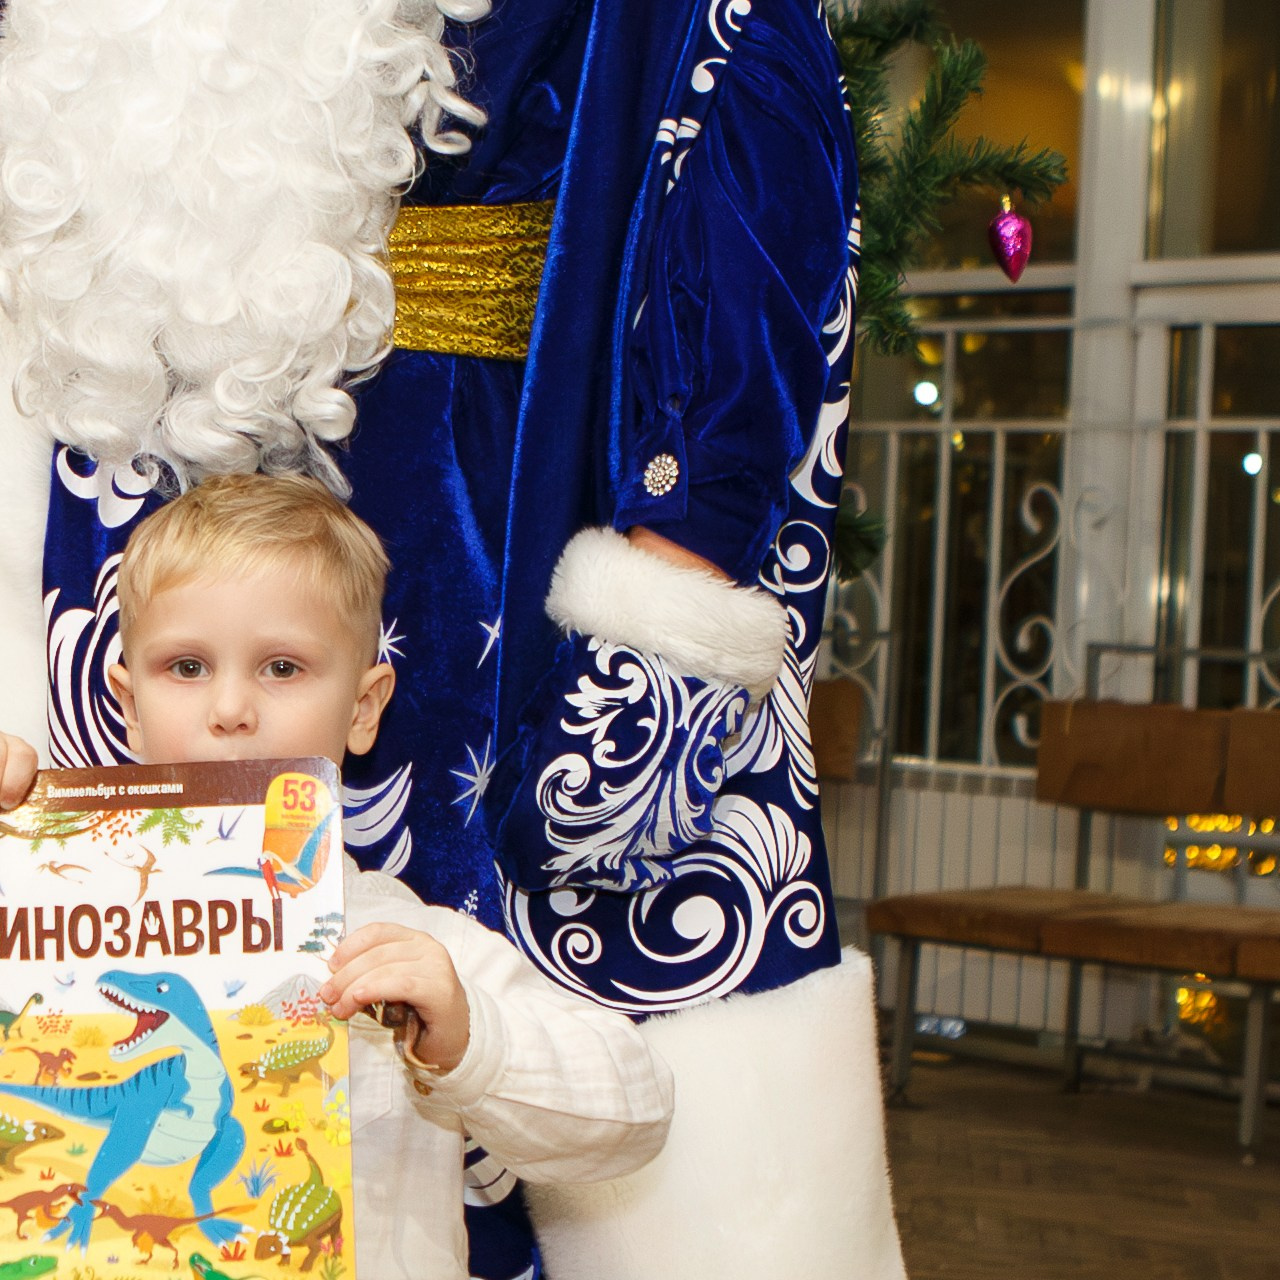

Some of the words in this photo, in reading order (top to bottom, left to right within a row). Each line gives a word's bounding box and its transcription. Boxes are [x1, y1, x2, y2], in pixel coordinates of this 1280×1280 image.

[46, 783, 117, 799] Виммельбух
[118, 784, 125, 795] с
[127, 783, 184, 796] окошками
[282, 779, 317, 812] 53
